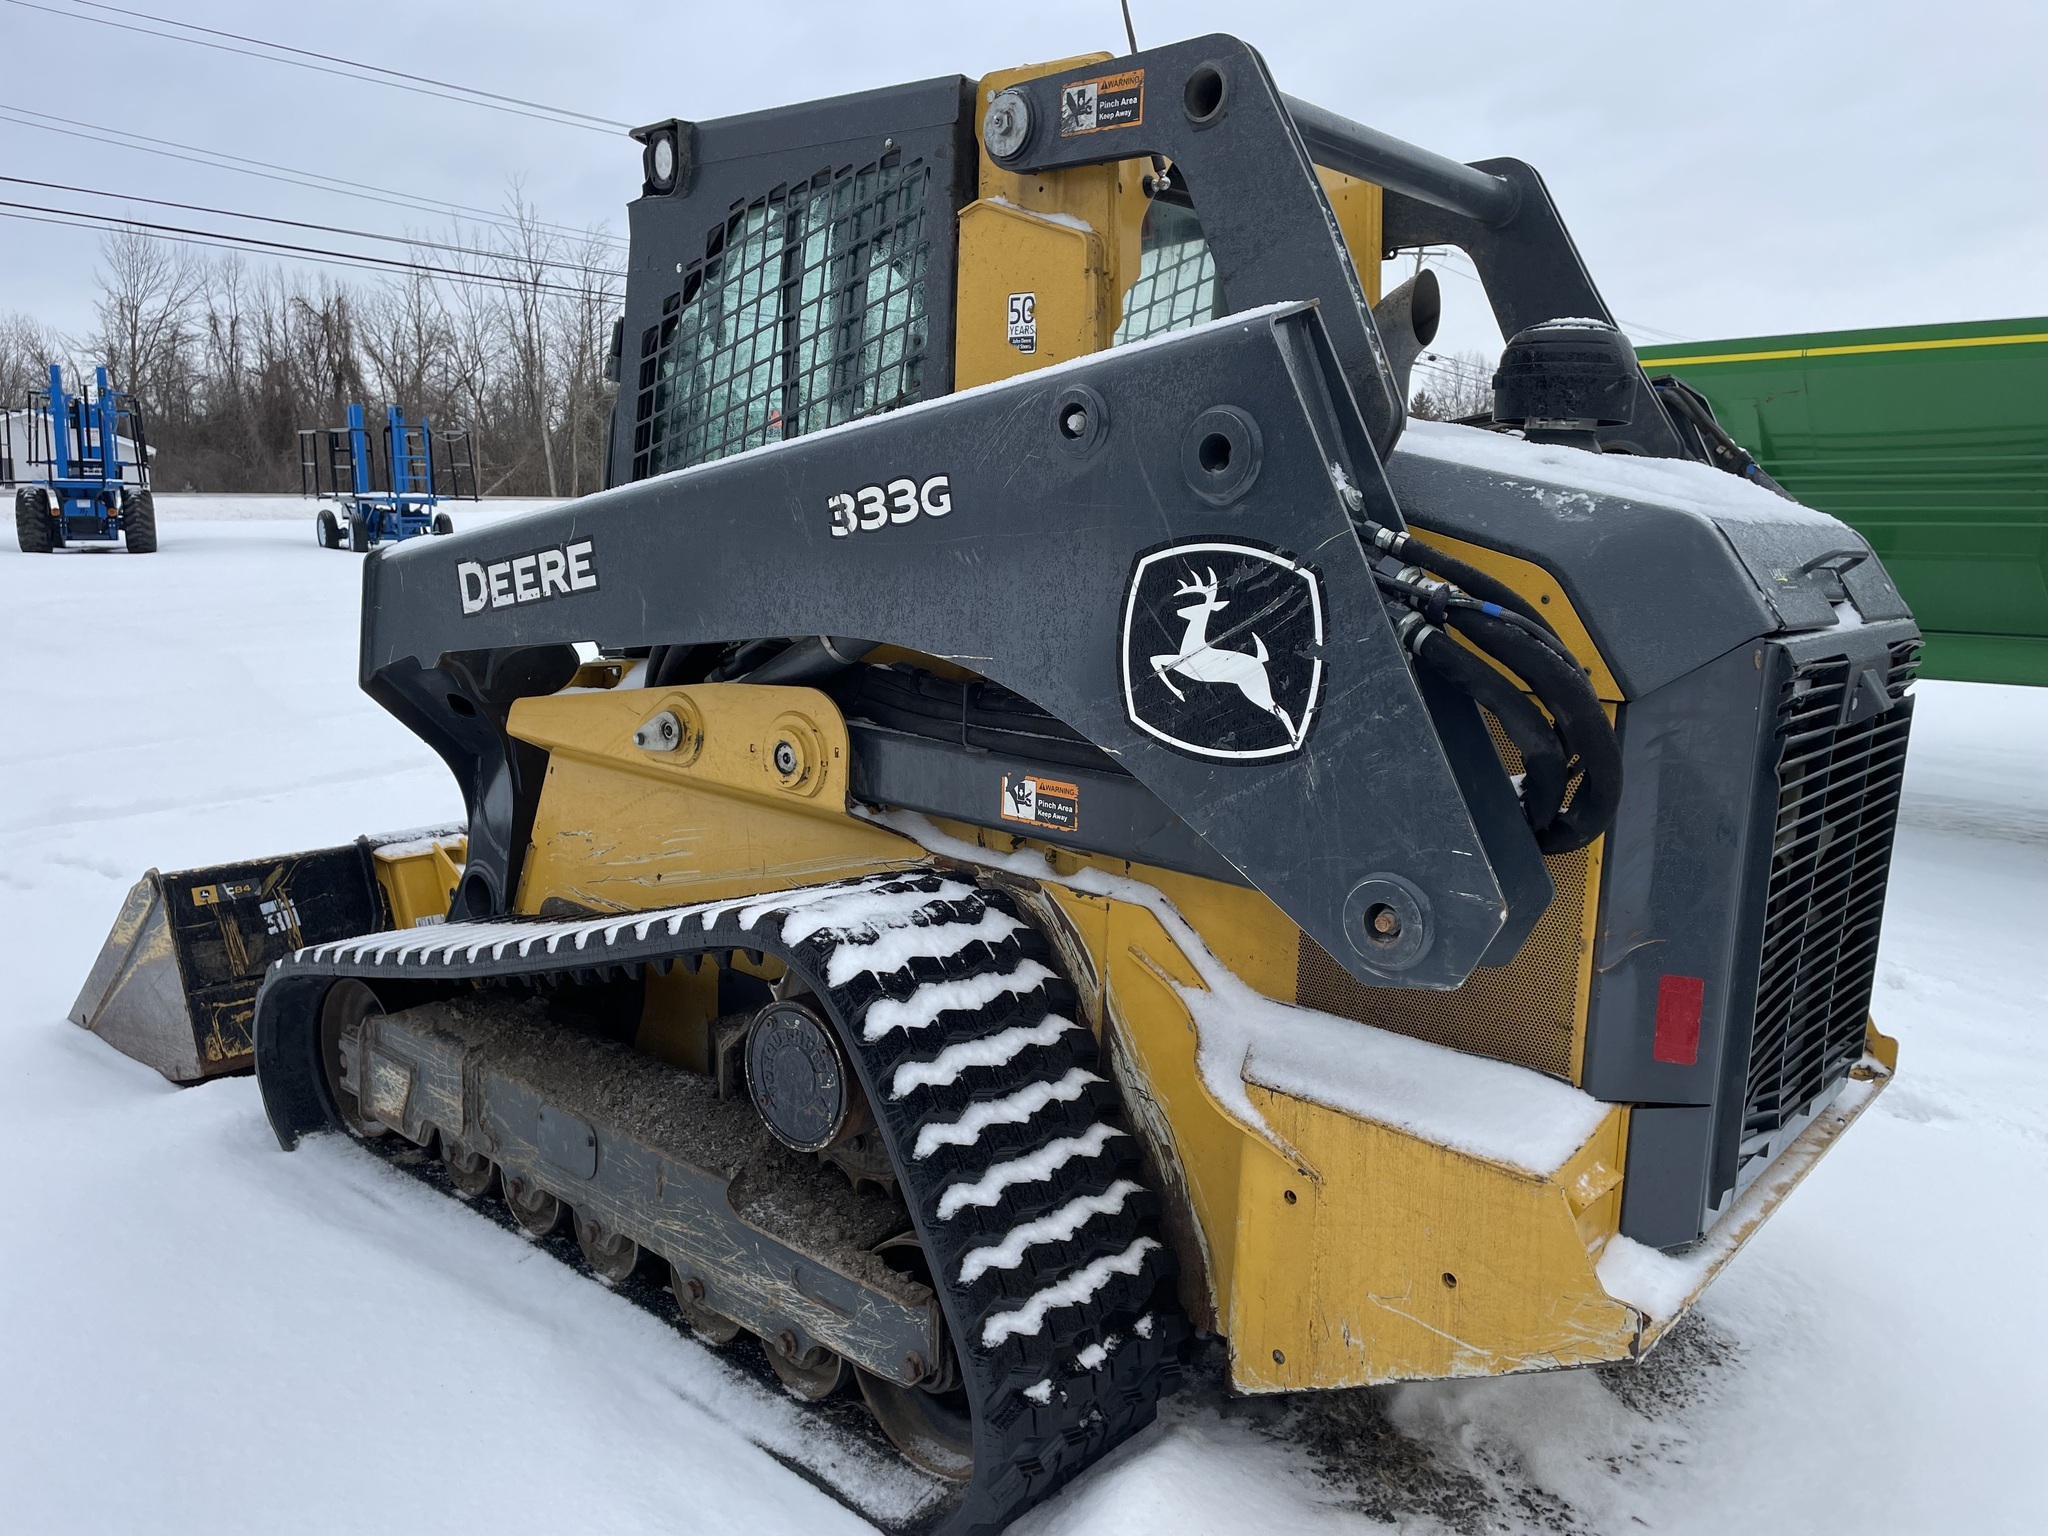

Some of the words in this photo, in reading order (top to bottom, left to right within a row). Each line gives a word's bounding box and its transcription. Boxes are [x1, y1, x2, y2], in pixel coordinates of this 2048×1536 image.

[1108, 75, 1140, 88] WARNING
[1099, 99, 1120, 110] Pinch
[1120, 97, 1138, 106] Area
[1098, 111, 1115, 120] Keep
[1115, 109, 1132, 118] Away
[1009, 295, 1035, 325] 50
[1009, 324, 1035, 336] YEARS
[828, 476, 952, 537] 333G
[457, 540, 597, 615] DEERE
[1045, 784, 1076, 796] WARNING
[1038, 799, 1057, 810] Pinch
[1057, 803, 1073, 813] Area
[1037, 809, 1052, 819] Keep
[1052, 812, 1068, 823] Away
